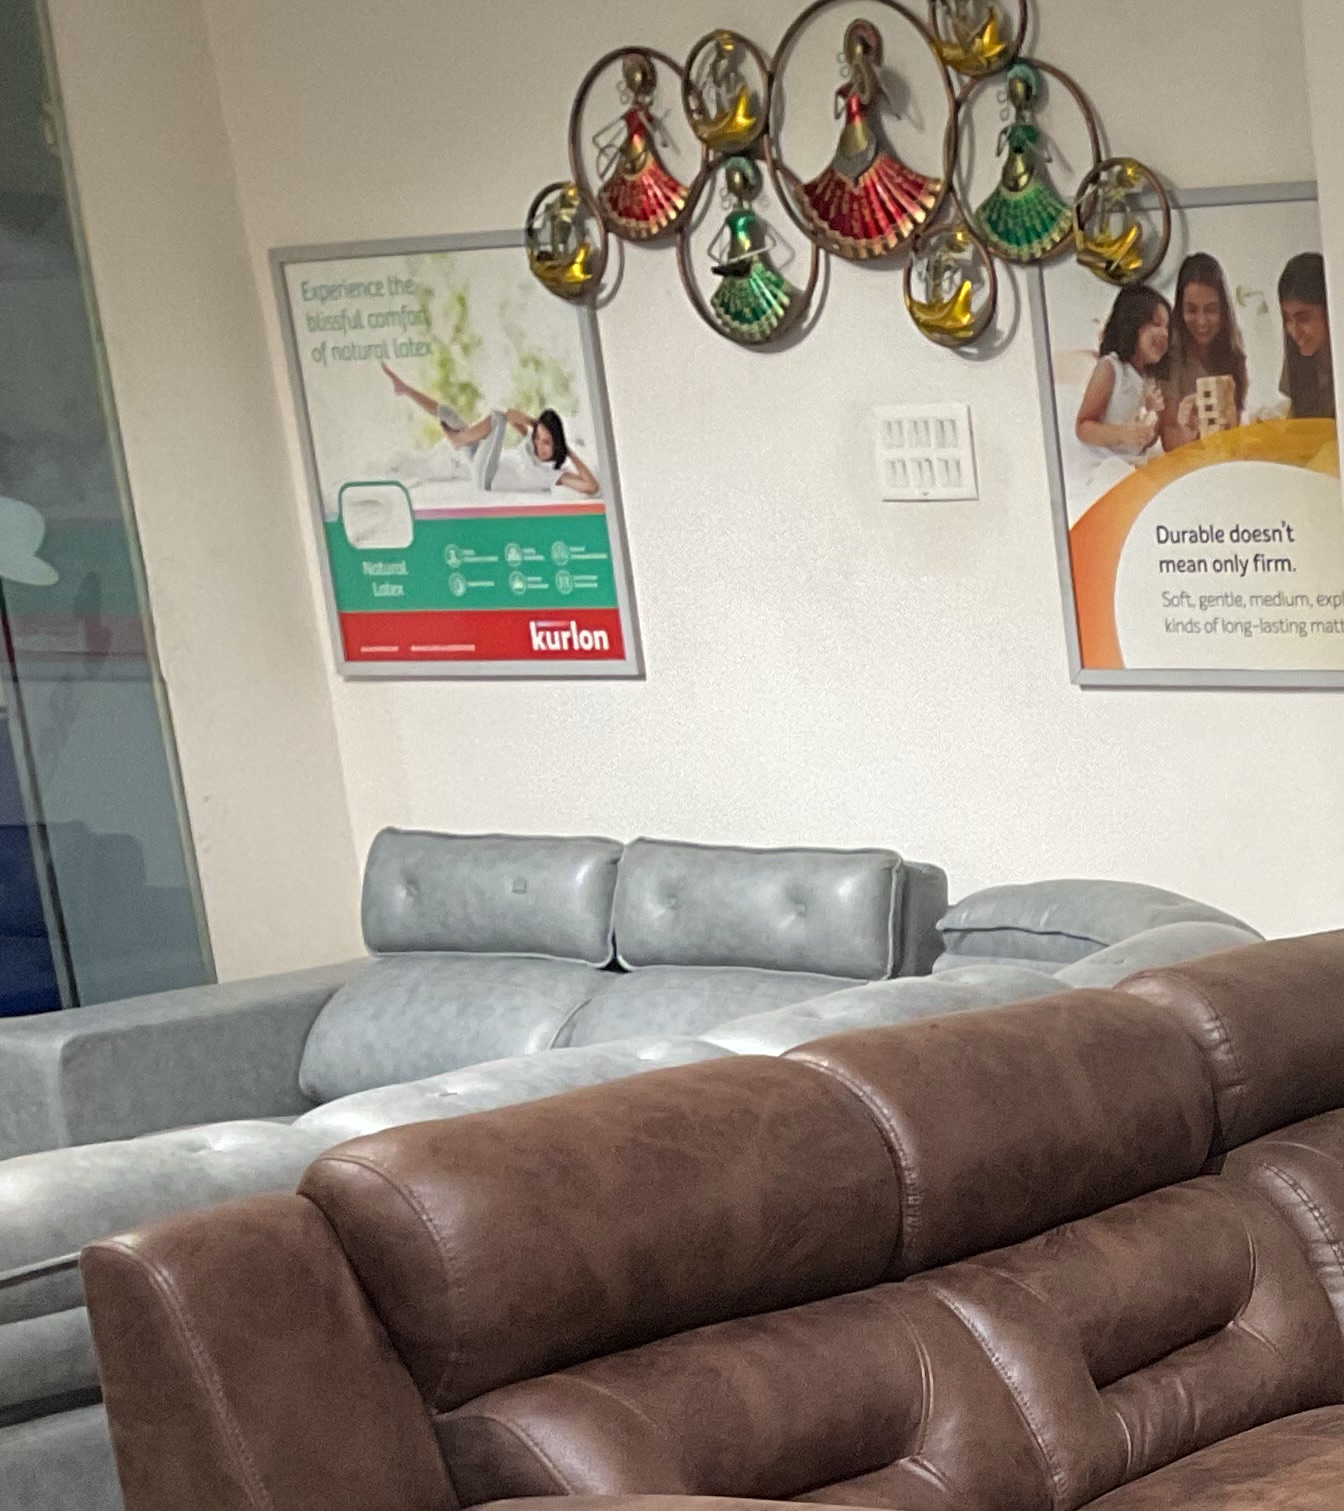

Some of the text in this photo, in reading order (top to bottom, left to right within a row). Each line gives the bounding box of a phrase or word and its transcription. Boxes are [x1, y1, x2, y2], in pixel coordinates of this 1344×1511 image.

[311, 340, 328, 367] of
[331, 341, 390, 361] natural
[1155, 520, 1296, 545] Durable doesn't
[1158, 552, 1298, 578] mean only firm.
[1161, 590, 1197, 609] Soft,
[1199, 590, 1247, 611] gentle,
[1249, 590, 1314, 608] medium,
[529, 620, 610, 651] kurlon
[1164, 616, 1201, 634] kinds
[1203, 615, 1220, 634] of
[1221, 615, 1308, 638] long-lasting
